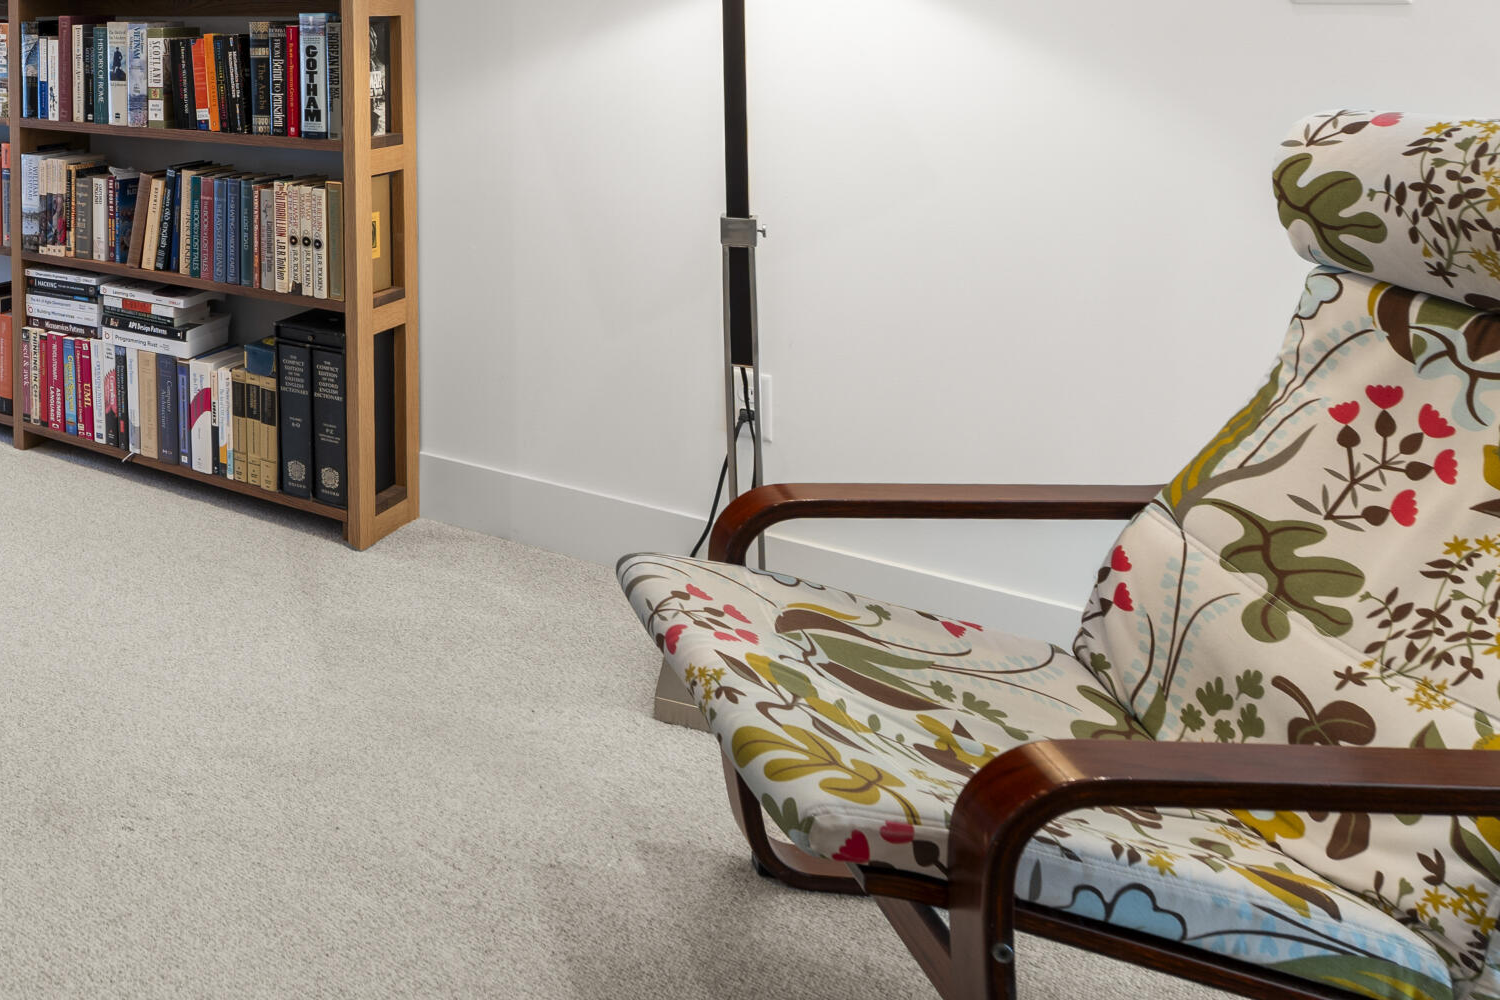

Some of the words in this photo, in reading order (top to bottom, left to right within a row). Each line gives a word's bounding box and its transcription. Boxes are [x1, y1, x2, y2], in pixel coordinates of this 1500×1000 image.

[133, 28, 141, 60] VIETNAM
[328, 32, 340, 66] KOREAN
[97, 38, 105, 68] HISTORY
[153, 41, 161, 84] SCOTLAND
[98, 70, 105, 79] OF
[258, 64, 266, 80] The
[272, 59, 285, 81] Beirut
[329, 67, 340, 86] WAR
[275, 83, 281, 93] TO
[304, 45, 322, 122] GOTHAM
[259, 83, 267, 110] Arabs
[271, 93, 285, 127] Jerusalem
[266, 221, 274, 253] Unfinished
[276, 240, 285, 257] J.R.R.
[276, 257, 286, 281] Tolkien
[37, 280, 57, 289] HACKING
[128, 321, 136, 329] API
[137, 323, 151, 333] Design
[151, 326, 167, 335] Patterns
[115, 334, 147, 347] Programming
[23, 360, 30, 368] &
[283, 359, 304, 367] COMPACT
[285, 365, 304, 373] EDITION
[316, 364, 339, 372] COMPACT
[33, 373, 39, 382] IN
[318, 370, 338, 378] EDITION
[281, 386, 309, 395] DICTIONARY
[285, 381, 305, 389] ENGLISH
[318, 381, 339, 389] OXFORD
[319, 387, 339, 395] ENGLISH
[83, 383, 92, 409] UML
[165, 380, 173, 413] Computer
[314, 392, 343, 401] DICTIONARY
